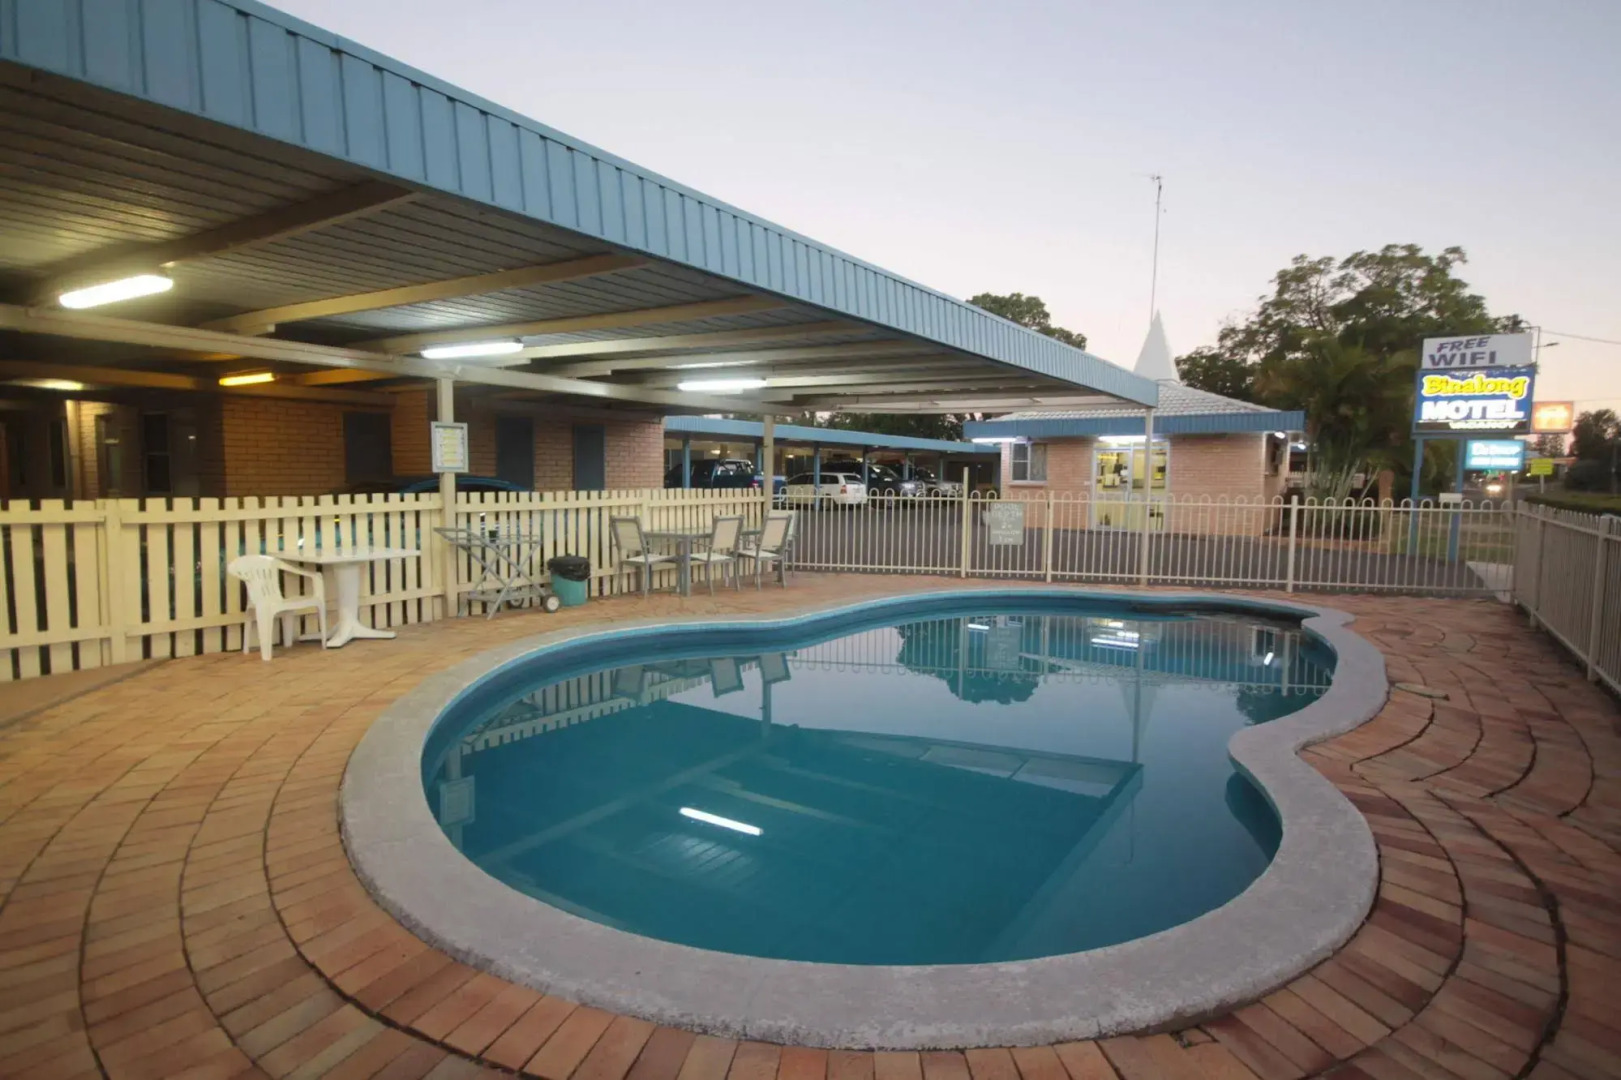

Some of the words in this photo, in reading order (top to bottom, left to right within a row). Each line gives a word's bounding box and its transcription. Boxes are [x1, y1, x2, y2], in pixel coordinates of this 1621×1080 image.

[1437, 336, 1491, 353] FREE
[1429, 351, 1497, 367] WIFI
[1423, 375, 1529, 399] Binalong
[1421, 400, 1525, 420] MOTEL
